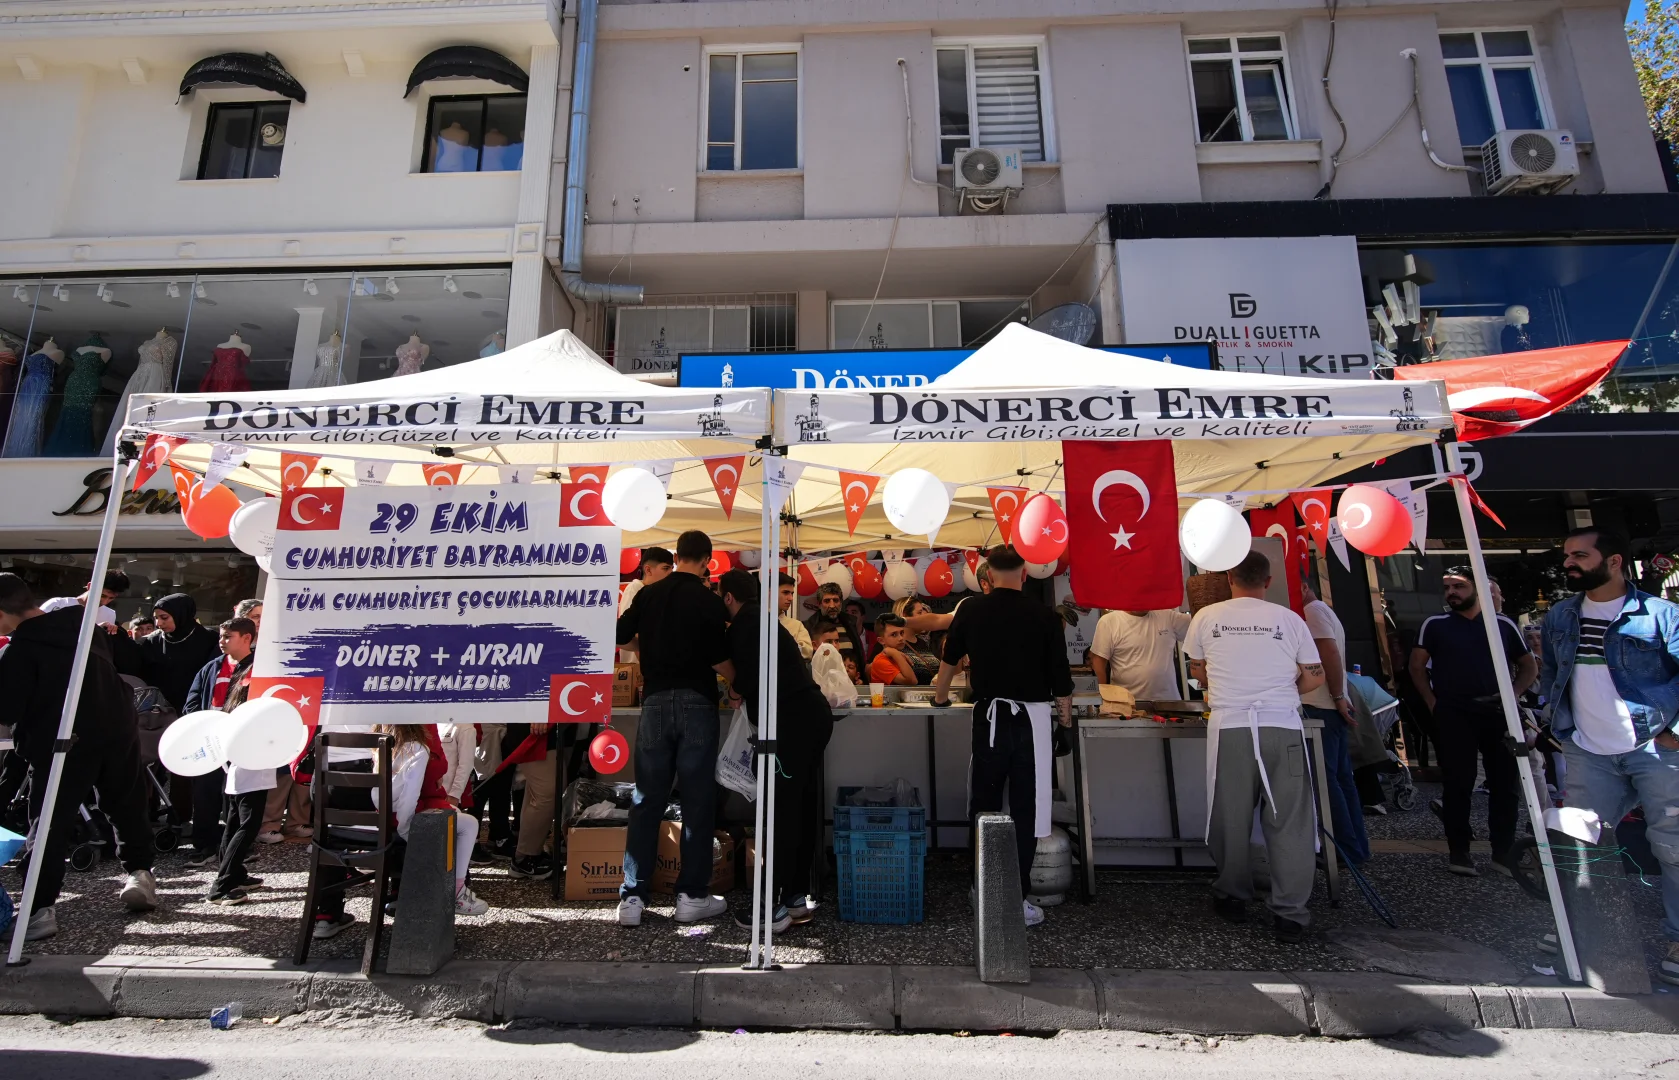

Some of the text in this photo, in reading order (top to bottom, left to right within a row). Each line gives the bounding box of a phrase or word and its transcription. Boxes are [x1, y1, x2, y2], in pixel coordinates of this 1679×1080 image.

[1253, 325, 1321, 339] GUETTA
[792, 368, 948, 388] DÖNER
[476, 394, 645, 425] EMRE
[1154, 387, 1333, 420] EMRE
[470, 430, 501, 441] ve
[515, 427, 621, 441] Kaliteli
[1153, 425, 1185, 437] ve
[1201, 421, 1313, 437] Kaliteli
[369, 490, 529, 533] 29 EKİM
[285, 537, 438, 570] CUMHURİYET
[444, 543, 608, 568] BAYRAMINDA
[286, 584, 613, 616] TÜM CUMHURİYET ÇOCUKLARIMIZA
[1253, 625, 1273, 633] EMRE
[336, 640, 543, 668] DÖNER + AYRAN
[363, 671, 511, 692] HEDİYEMİZDİR
[656, 854, 682, 871] Şırla
